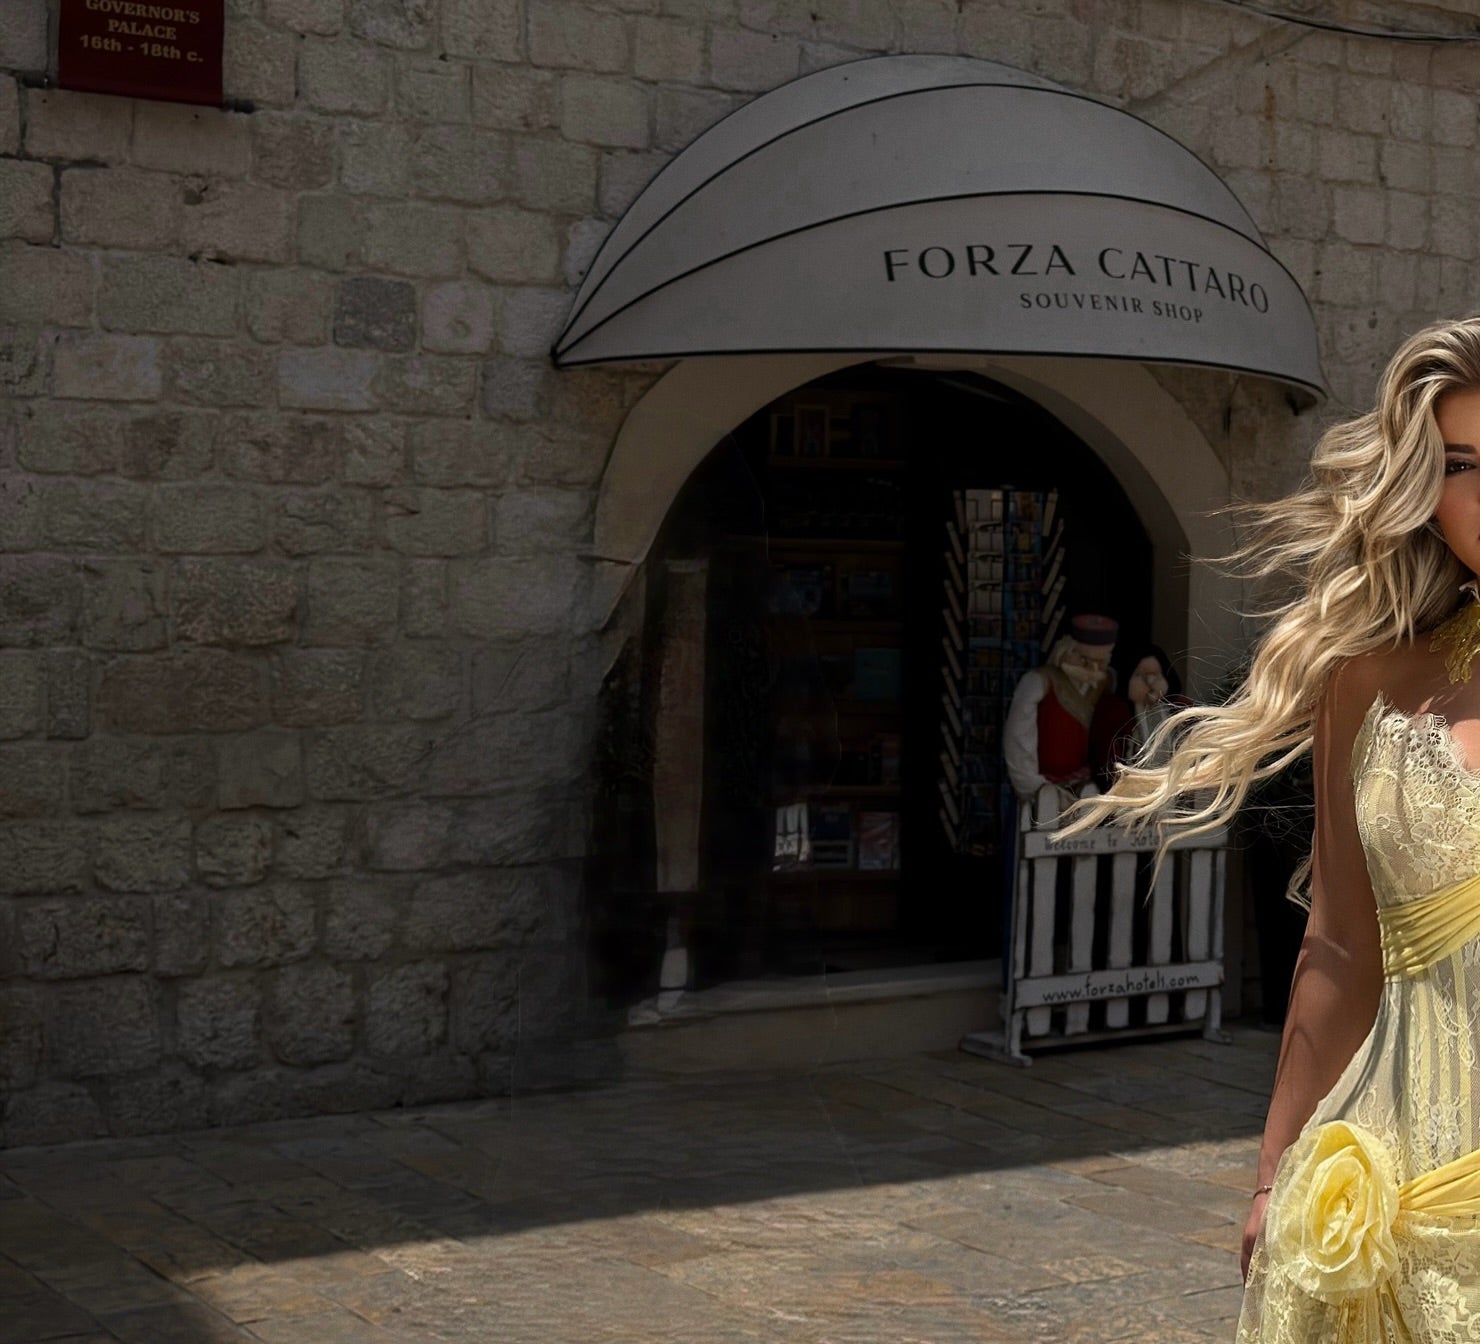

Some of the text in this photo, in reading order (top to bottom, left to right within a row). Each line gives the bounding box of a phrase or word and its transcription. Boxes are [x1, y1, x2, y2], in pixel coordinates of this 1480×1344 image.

[108, 19, 177, 40] PALACE
[80, 34, 122, 52] 16th
[139, 42, 181, 60] 18th
[186, 50, 204, 62] c.
[883, 243, 1270, 314] FORZA CATTARO
[1020, 292, 1204, 323] SOUVENIR SHOP
